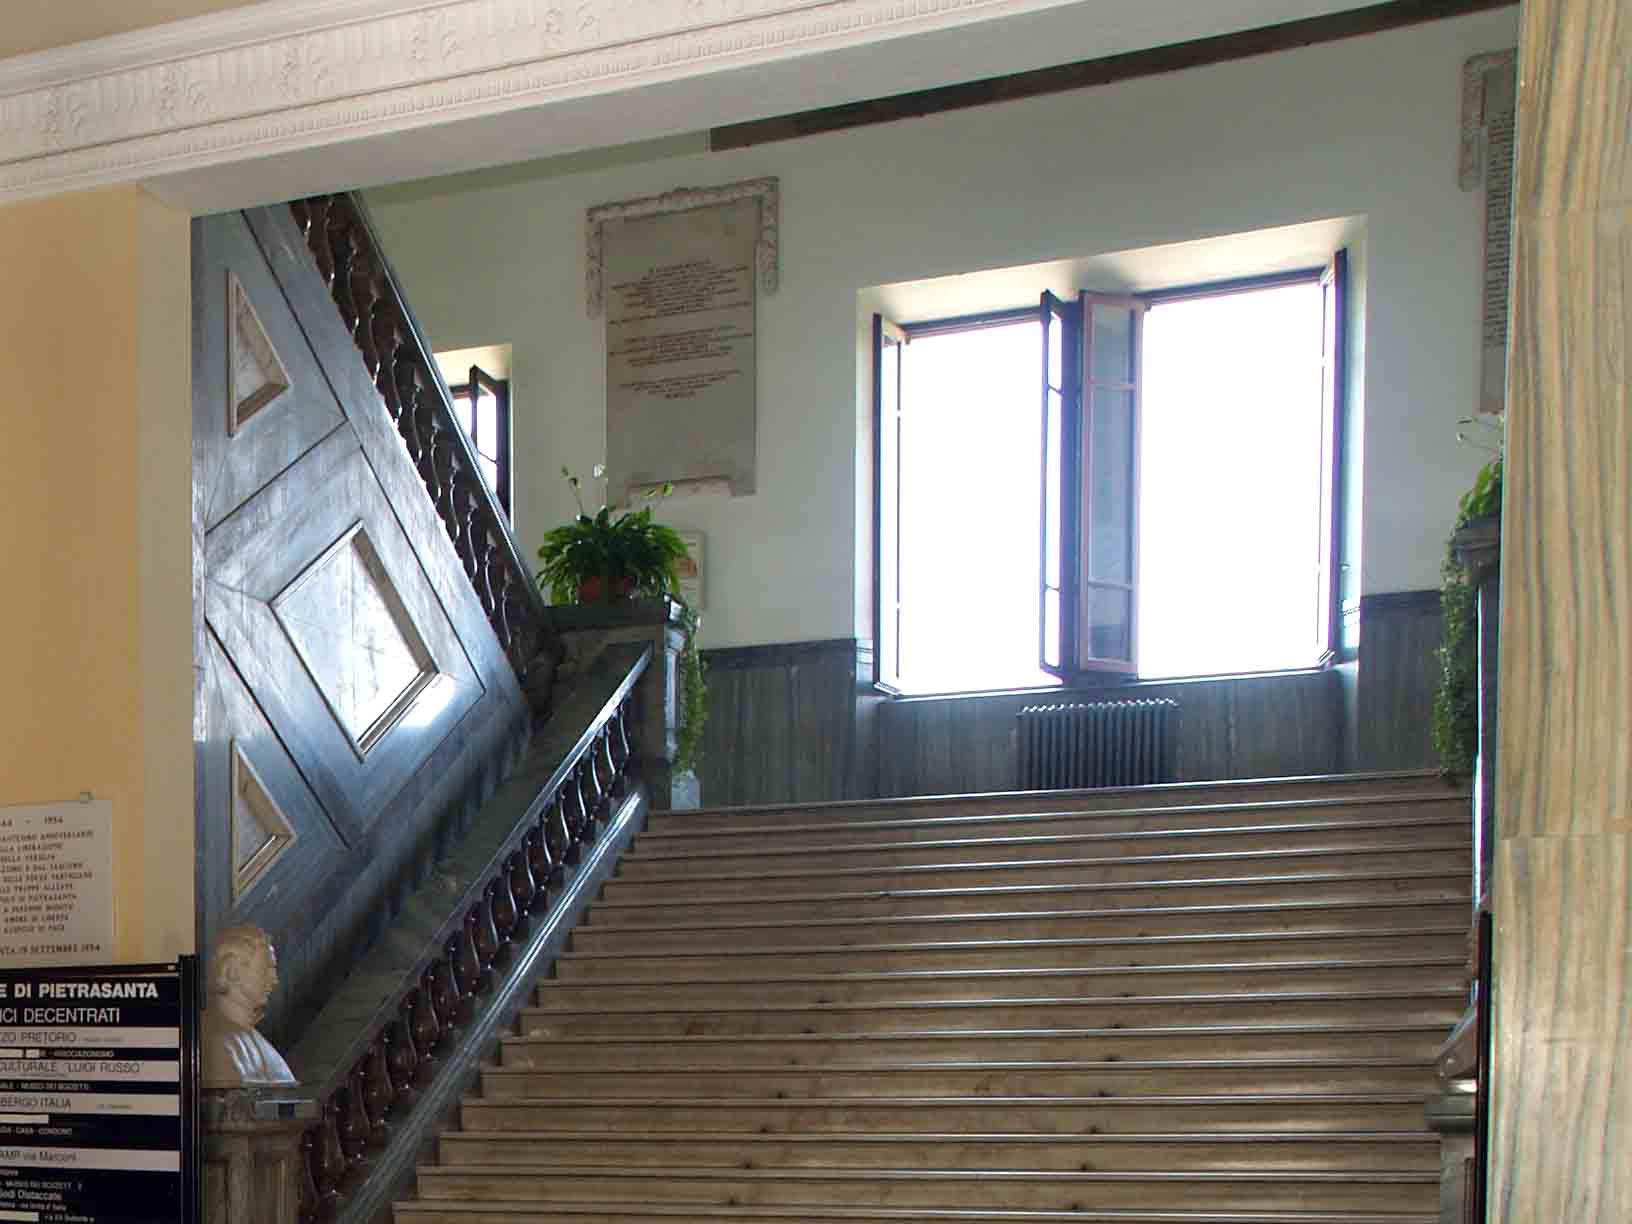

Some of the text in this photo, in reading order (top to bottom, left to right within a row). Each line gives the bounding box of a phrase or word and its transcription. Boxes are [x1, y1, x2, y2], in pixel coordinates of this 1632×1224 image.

[14, 983, 31, 998] DI
[39, 982, 159, 998] PIETRASANTA
[24, 1007, 120, 1023] DECENTRATI
[21, 1031, 77, 1043] PRETORIO
[40, 1097, 71, 1109] ITALIA
